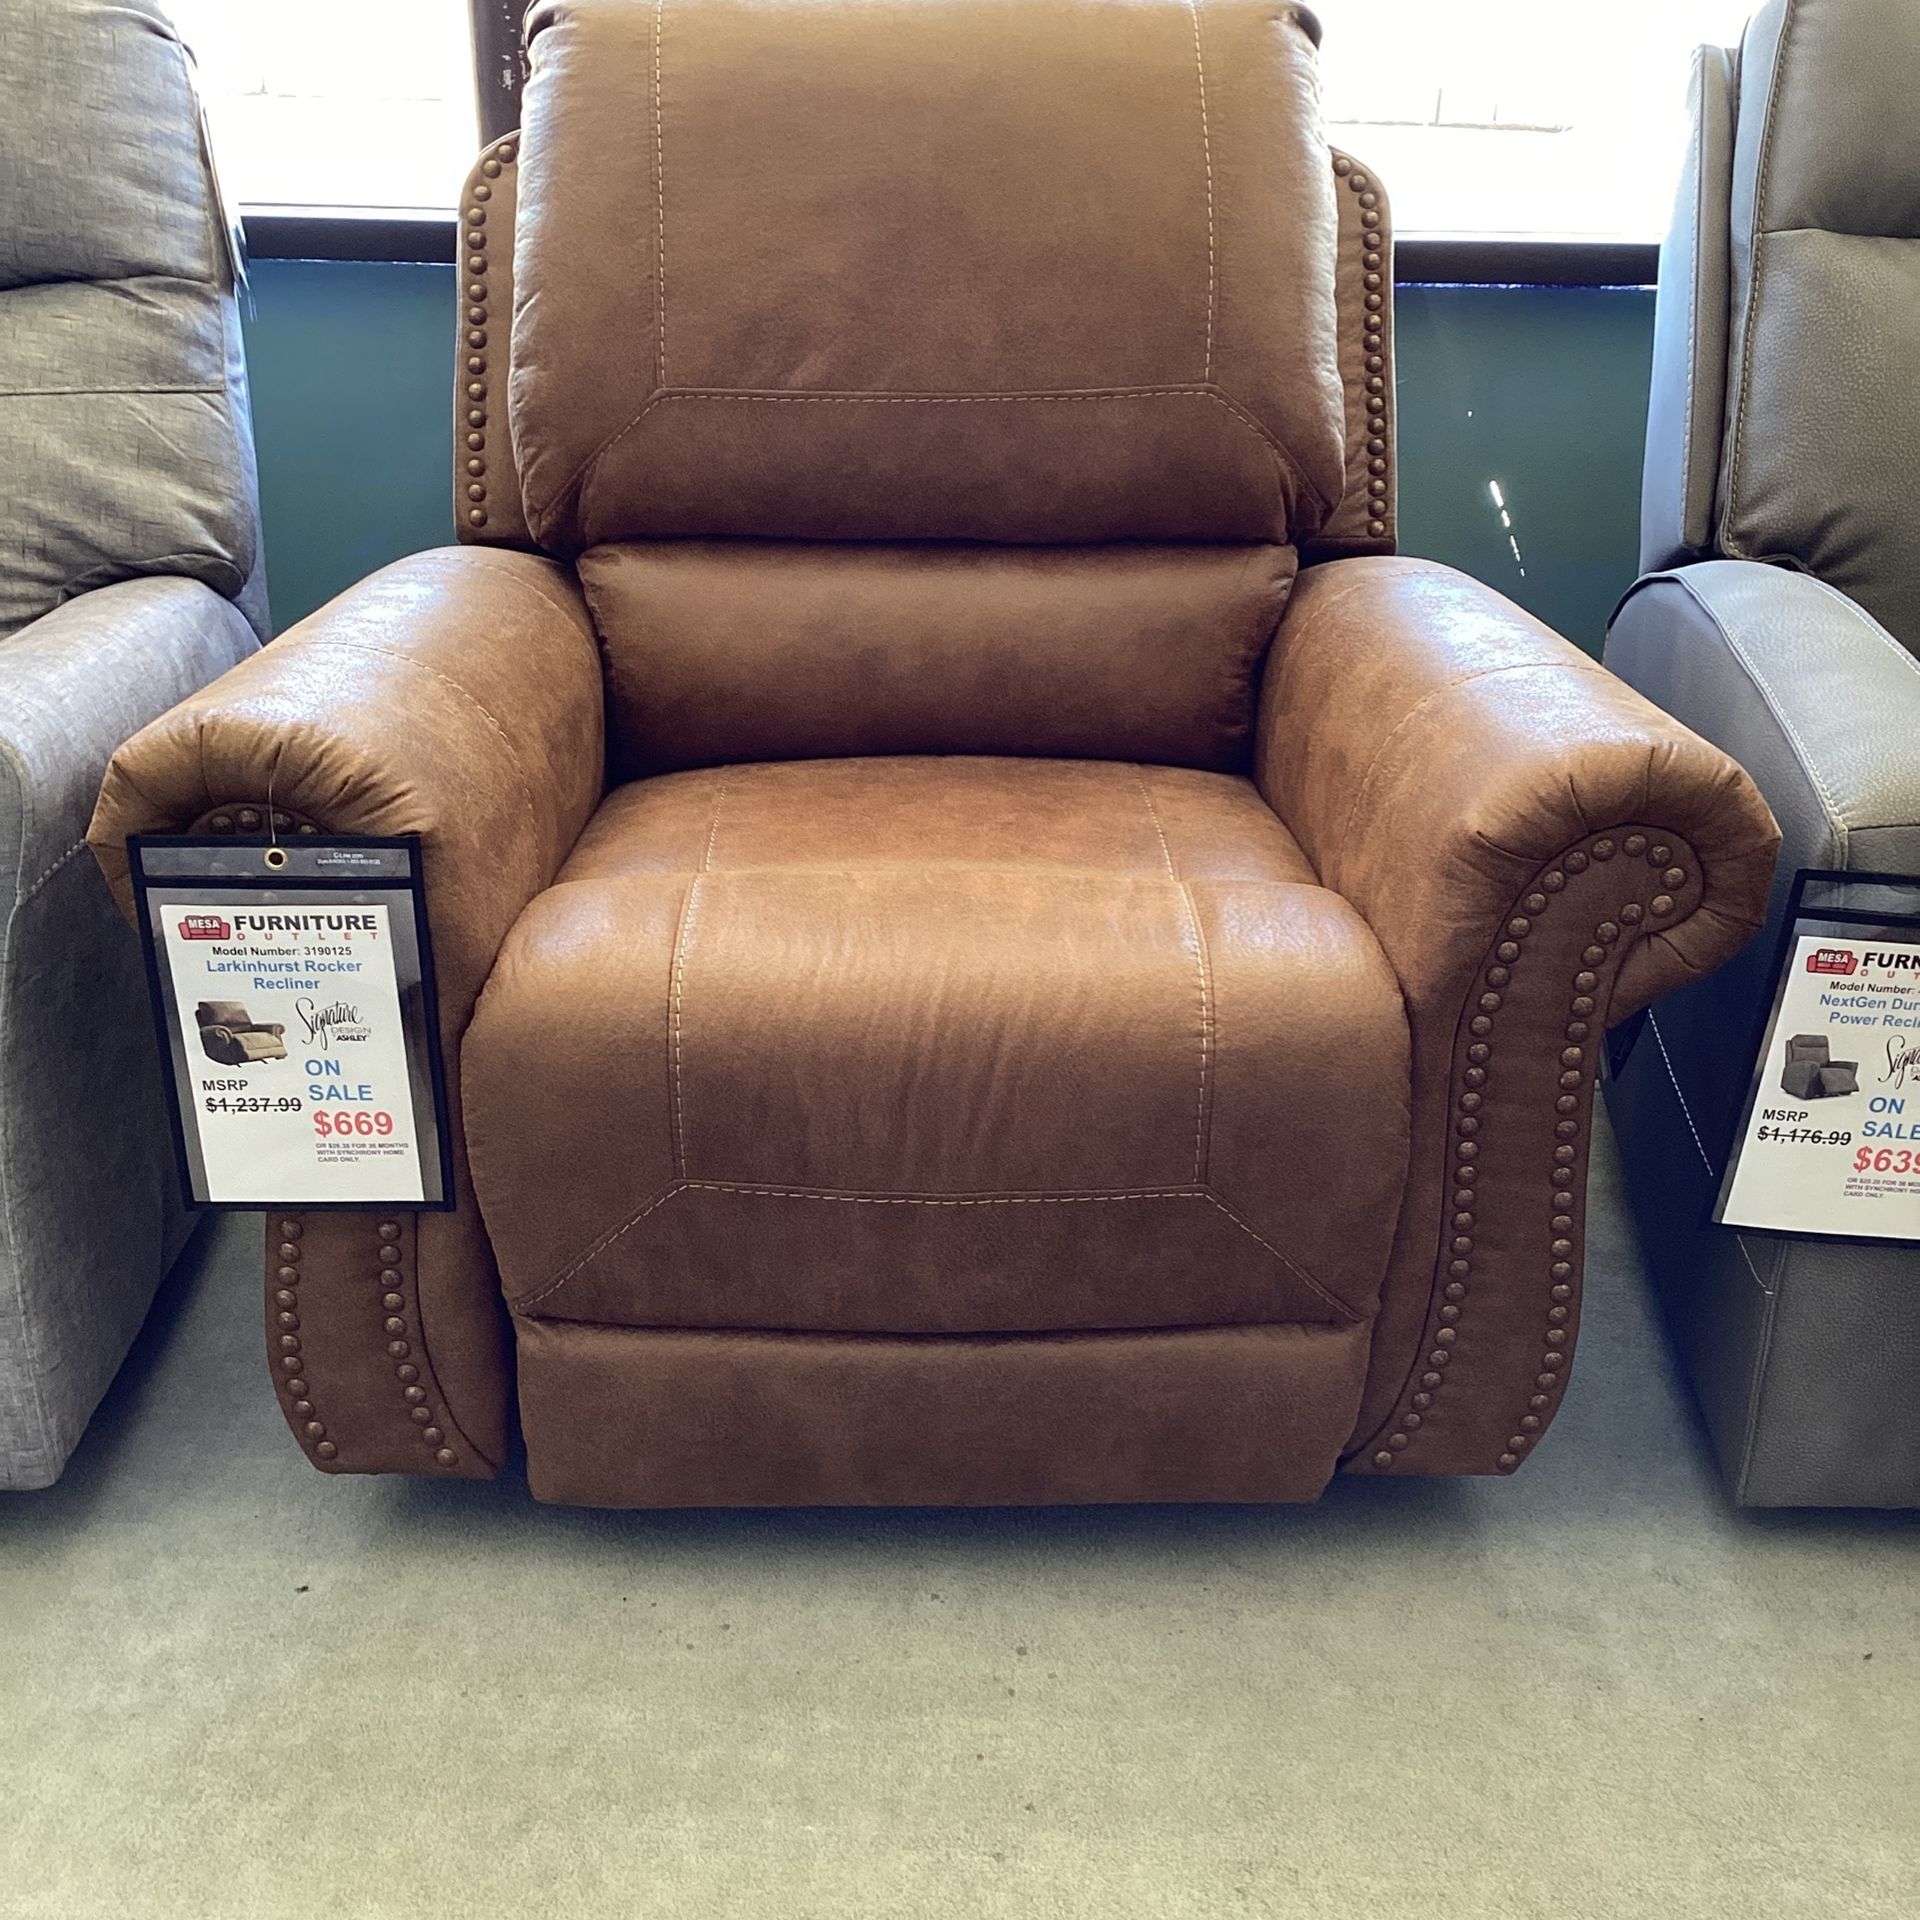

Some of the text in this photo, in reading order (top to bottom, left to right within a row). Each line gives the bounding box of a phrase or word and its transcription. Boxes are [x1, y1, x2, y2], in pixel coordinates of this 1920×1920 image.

[188, 914, 377, 931] MESA FURNITURE
[236, 931, 379, 941] OUTLET
[212, 946, 352, 956] Model Number: 3190125
[1817, 952, 1849, 963] MESA
[206, 960, 363, 973] Larkinhurst Rocker
[253, 977, 320, 989] Recliner
[1829, 981, 1915, 995] Model Number:
[1819, 994, 1887, 1009] NextGen
[295, 996, 365, 1051] Signature
[1829, 1011, 1879, 1025] Power
[335, 1034, 368, 1042] ASHLEY
[305, 1059, 341, 1076] ON
[202, 1079, 248, 1091] MSRP
[308, 1084, 373, 1101] SALE
[205, 1096, 303, 1115] $1,237.99
[1868, 1096, 1906, 1115] ON
[1762, 1108, 1809, 1123] MSRP
[312, 1110, 394, 1138] $669
[1862, 1120, 1920, 1140] SALE
[1757, 1125, 1852, 1147] $1,176.99
